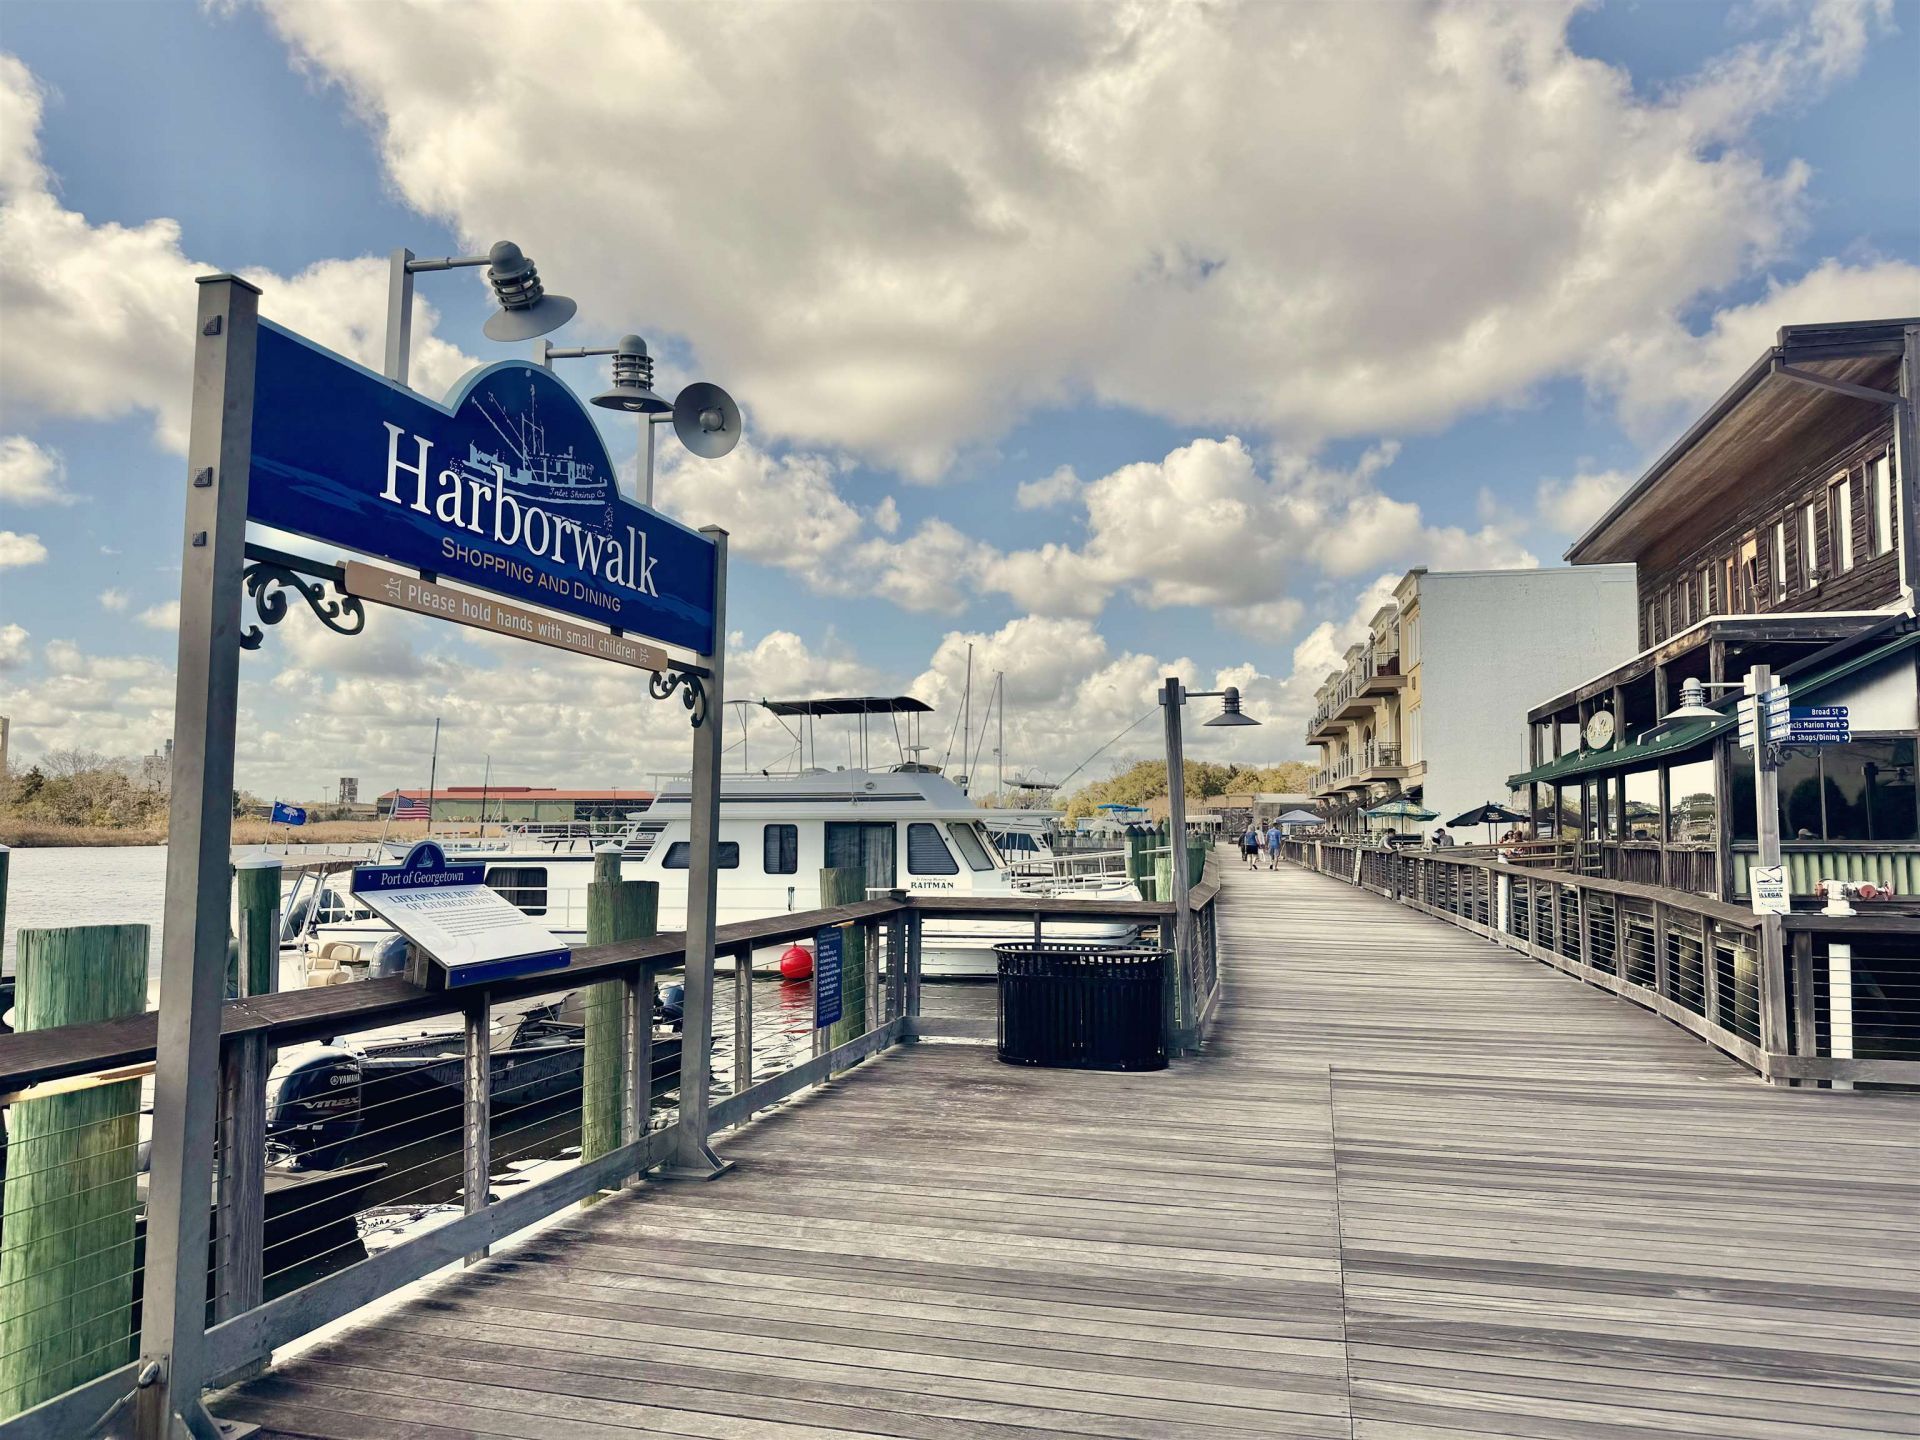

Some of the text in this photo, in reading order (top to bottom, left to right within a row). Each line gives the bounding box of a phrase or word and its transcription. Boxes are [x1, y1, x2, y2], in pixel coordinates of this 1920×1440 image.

[549, 487, 569, 498] Inlet
[570, 490, 595, 500] Shrimp
[379, 420, 659, 598] Harborwalk
[441, 536, 621, 612] SHOPPING AND DINING
[408, 584, 636, 660] Please hold hands with small children
[1811, 708, 1839, 716] Broad St
[1803, 721, 1825, 729] Marion
[1826, 720, 1840, 729] Park
[1797, 733, 1840, 742] Shops/Dining
[381, 870, 464, 886] Port of Georgetown
[388, 889, 491, 904] LIFE ON THE RIVERS
[407, 897, 497, 910] OF GEORGETOWN
